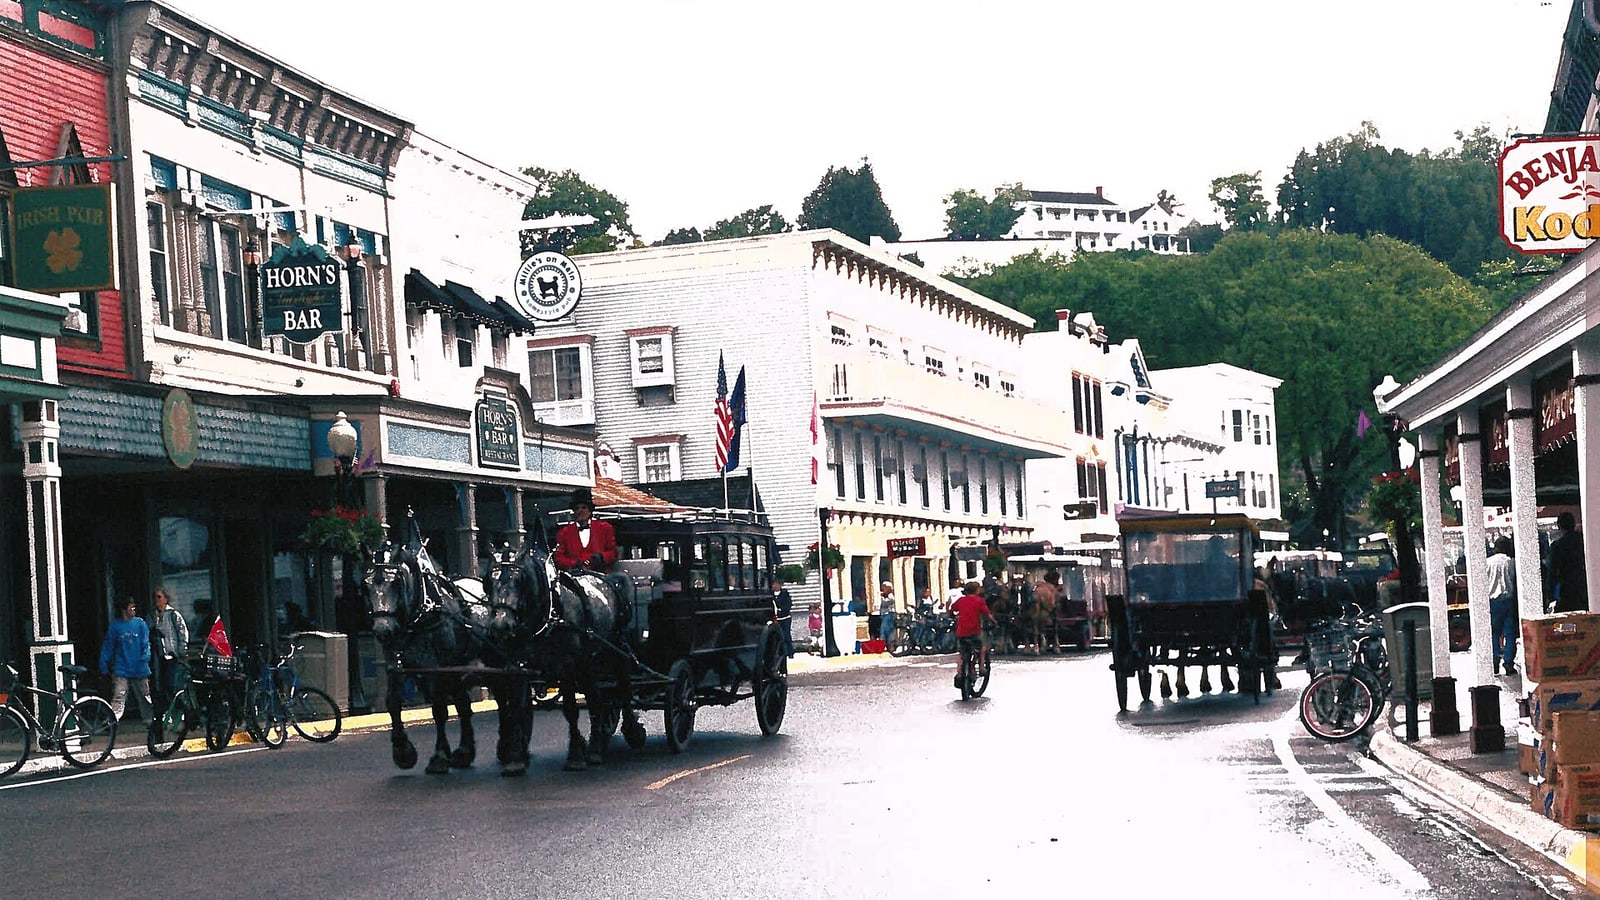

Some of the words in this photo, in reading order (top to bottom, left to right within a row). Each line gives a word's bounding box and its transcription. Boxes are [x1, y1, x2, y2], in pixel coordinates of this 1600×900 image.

[1505, 145, 1600, 200] BENJA
[18, 206, 59, 229] IRISH
[67, 206, 103, 225] PUB
[265, 264, 336, 288] HORN'S
[560, 260, 576, 281] Main
[283, 308, 323, 331] BAR
[483, 409, 513, 427] HORN'S
[491, 430, 508, 446] BAR
